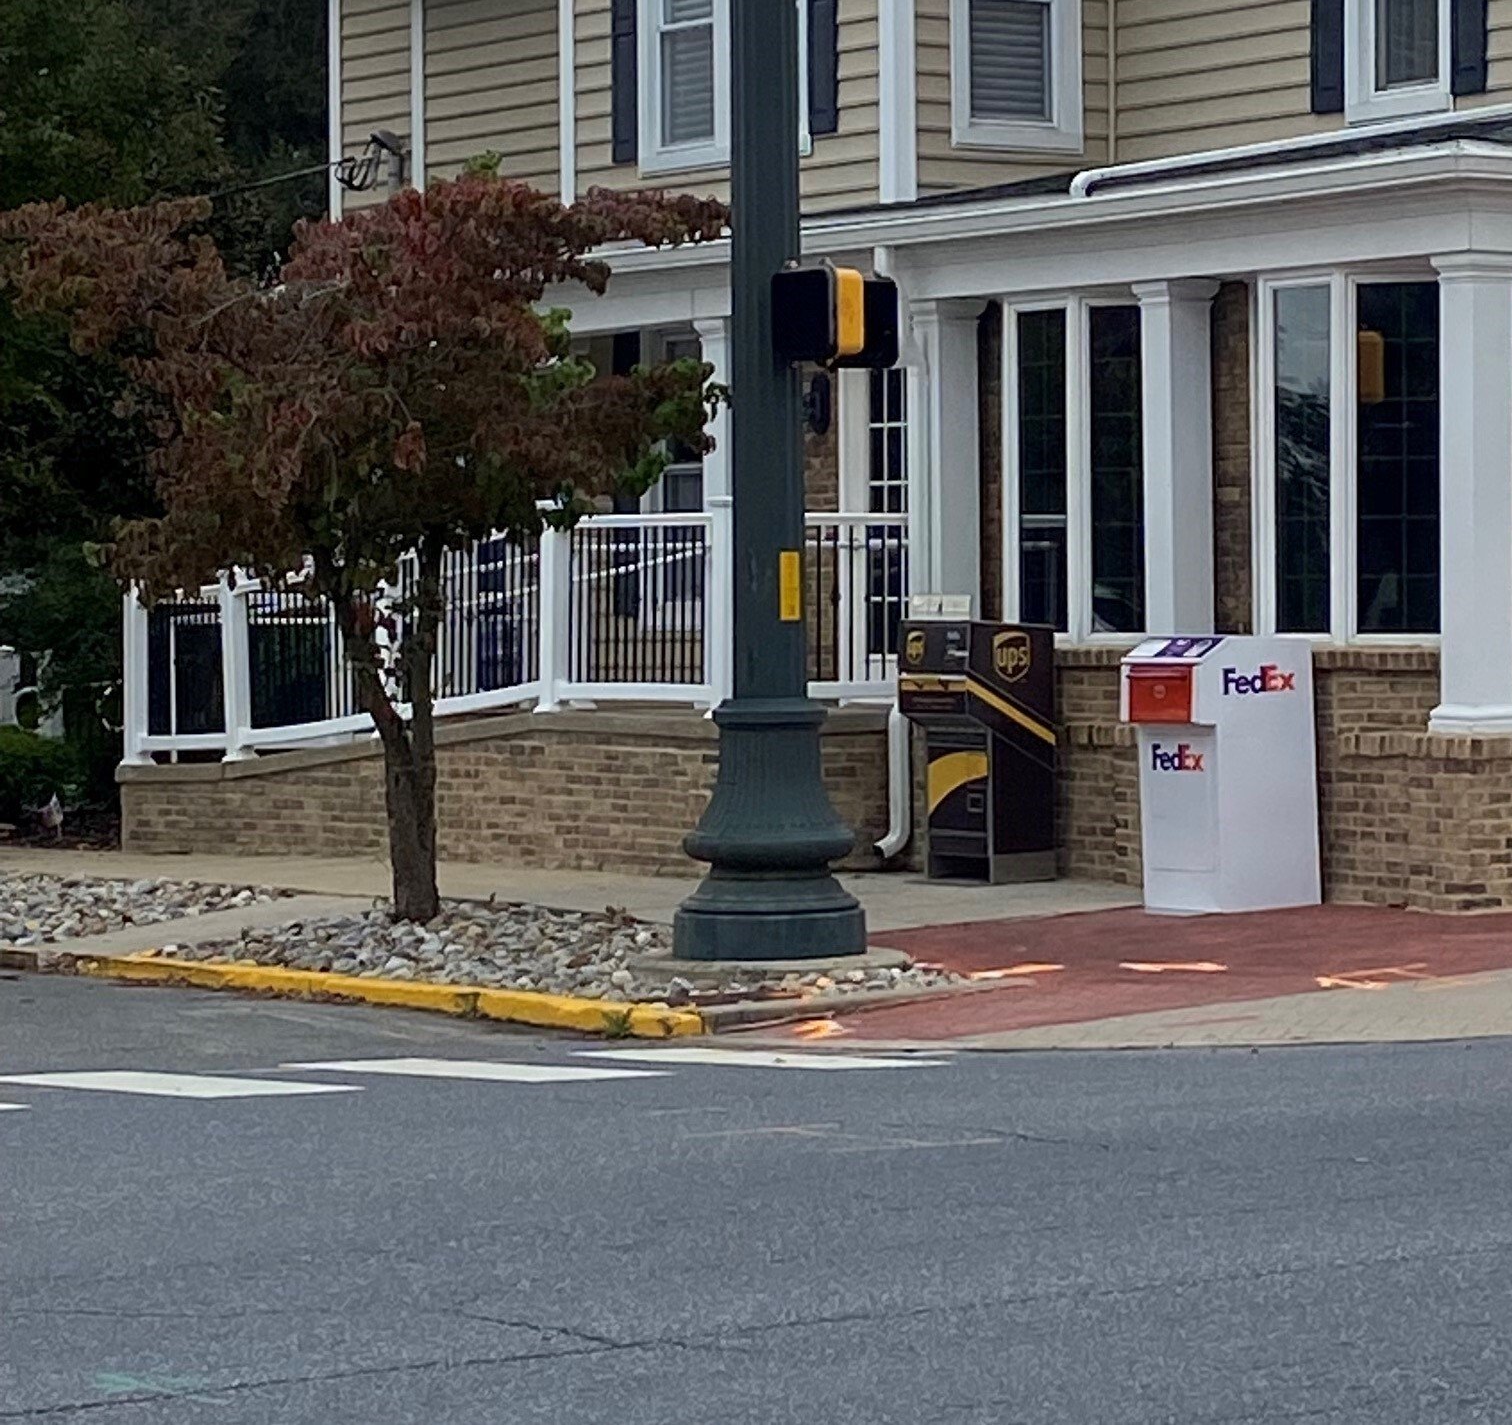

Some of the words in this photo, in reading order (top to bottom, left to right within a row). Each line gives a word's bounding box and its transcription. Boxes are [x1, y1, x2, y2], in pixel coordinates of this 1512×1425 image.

[997, 645, 1028, 674] ups
[1222, 664, 1296, 696] FedEx
[1151, 742, 1204, 772] FedEx
